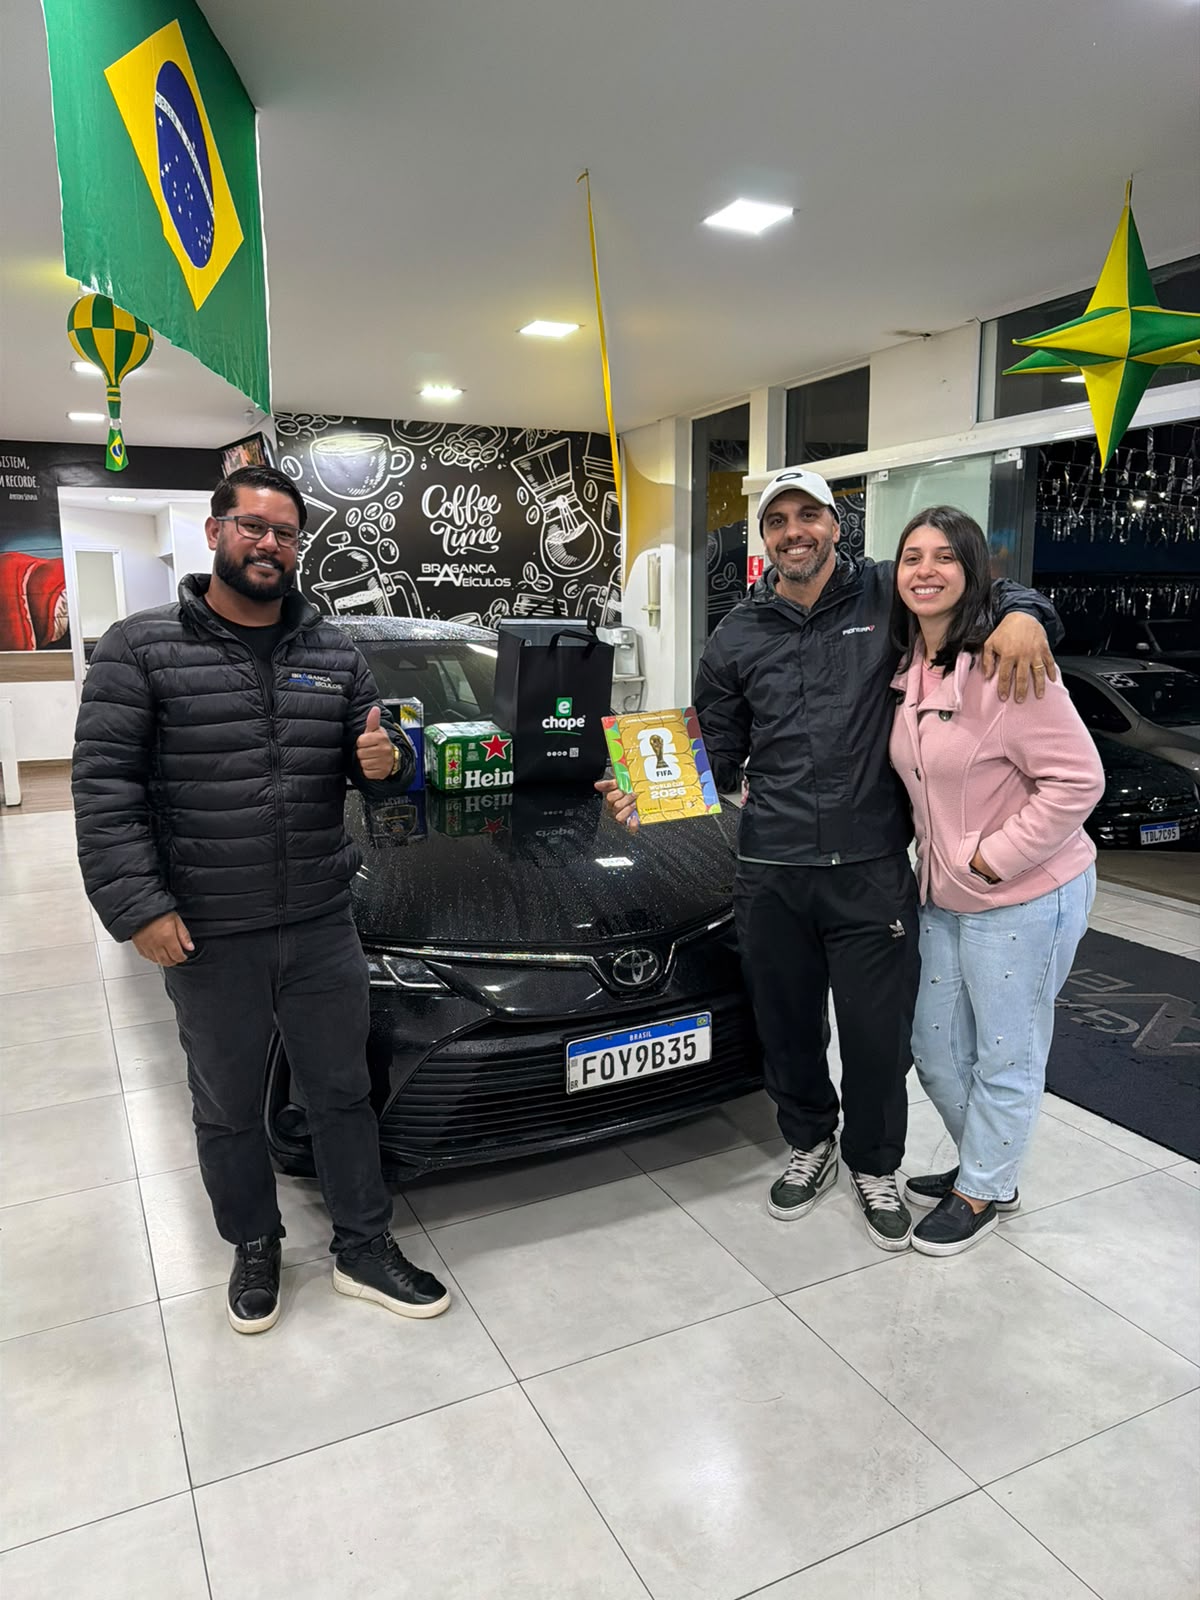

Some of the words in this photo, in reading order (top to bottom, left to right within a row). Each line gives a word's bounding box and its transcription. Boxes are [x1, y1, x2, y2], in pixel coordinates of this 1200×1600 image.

[5, 475, 40, 488] RECORDE.
[421, 484, 502, 526] Coffee
[430, 520, 502, 557] Time
[421, 563, 497, 578] BRAGANÇA
[558, 700, 571, 715] e
[541, 715, 585, 731] chope
[464, 768, 514, 789] Hein
[655, 769, 673, 778] FIFA
[650, 787, 687, 800] 2026
[629, 1031, 652, 1042] BRASIL
[570, 1080, 579, 1090] BR
